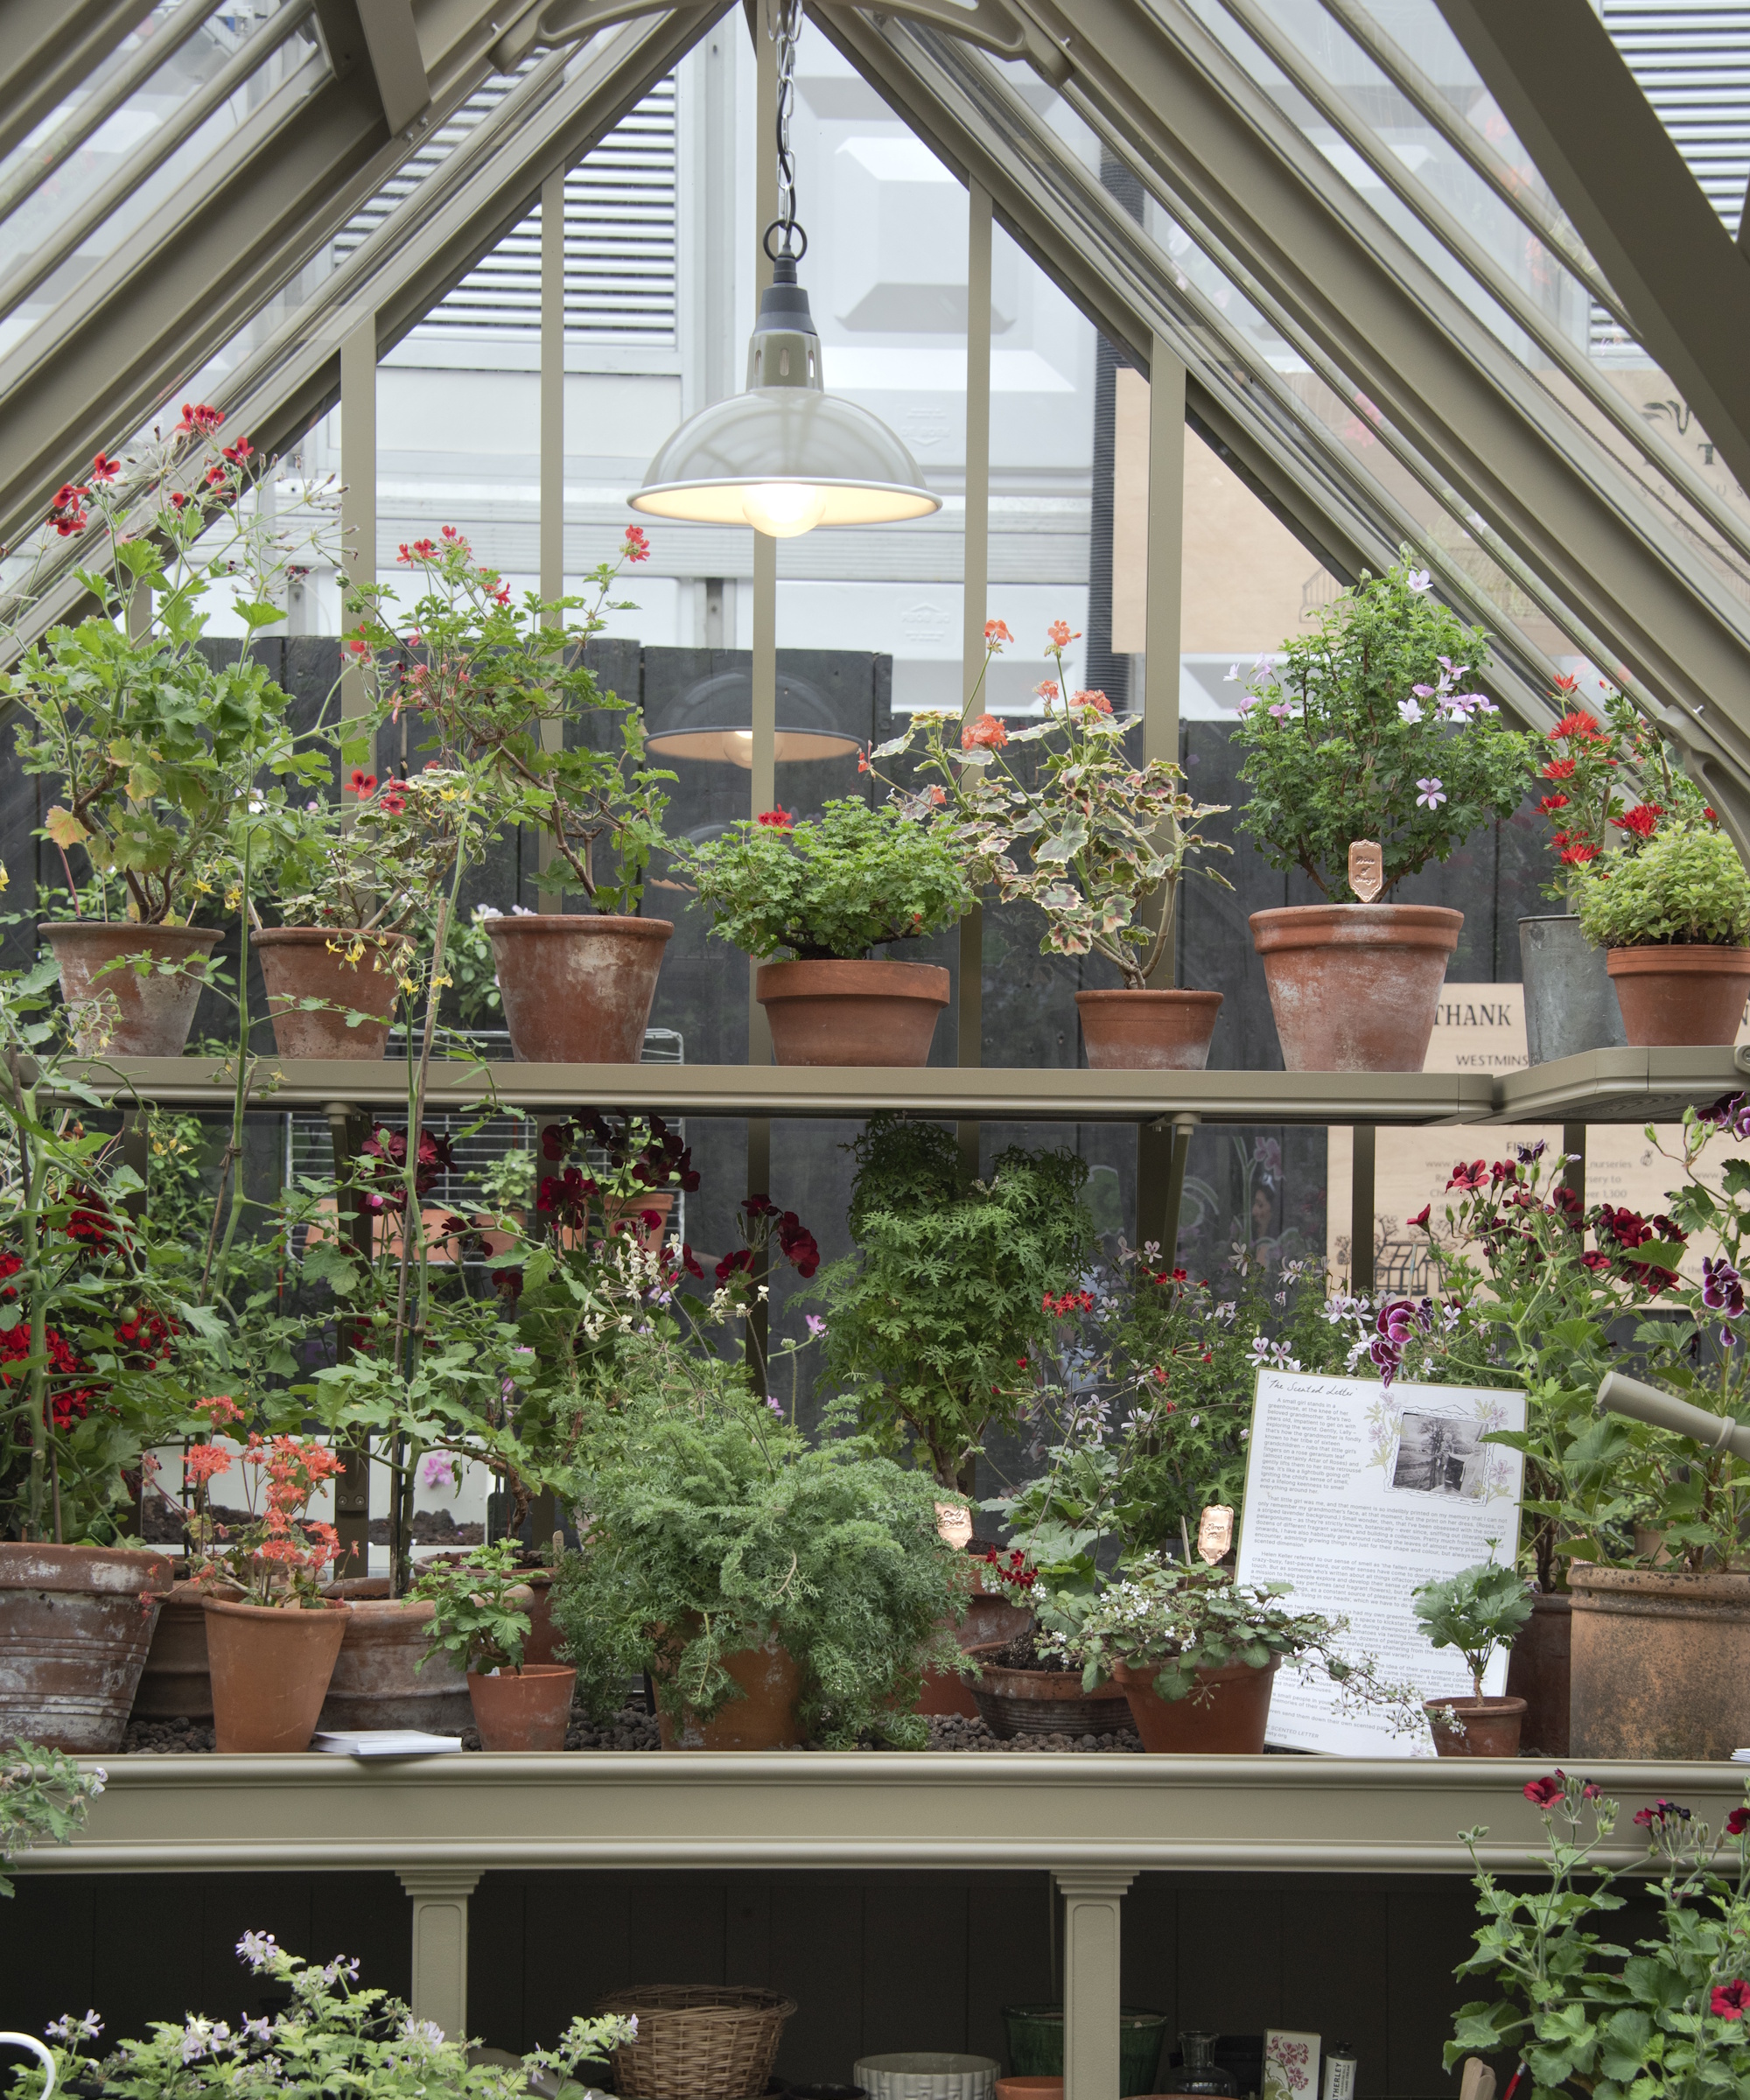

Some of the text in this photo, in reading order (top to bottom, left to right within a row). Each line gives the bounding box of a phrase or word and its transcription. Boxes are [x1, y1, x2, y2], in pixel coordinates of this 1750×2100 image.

[1434, 1005, 1511, 1026] THANK
[1456, 1055, 1528, 1065] WESTMINS
[1287, 1382, 1324, 1394] Scented
[1261, 1470, 1281, 1478] igniting
[1276, 1478, 1296, 1487] lifelong
[1387, 1507, 1409, 1515] indelibly
[1387, 1632, 1407, 1641] twining
[1271, 1726, 1319, 1738] SCENTED LETTER
